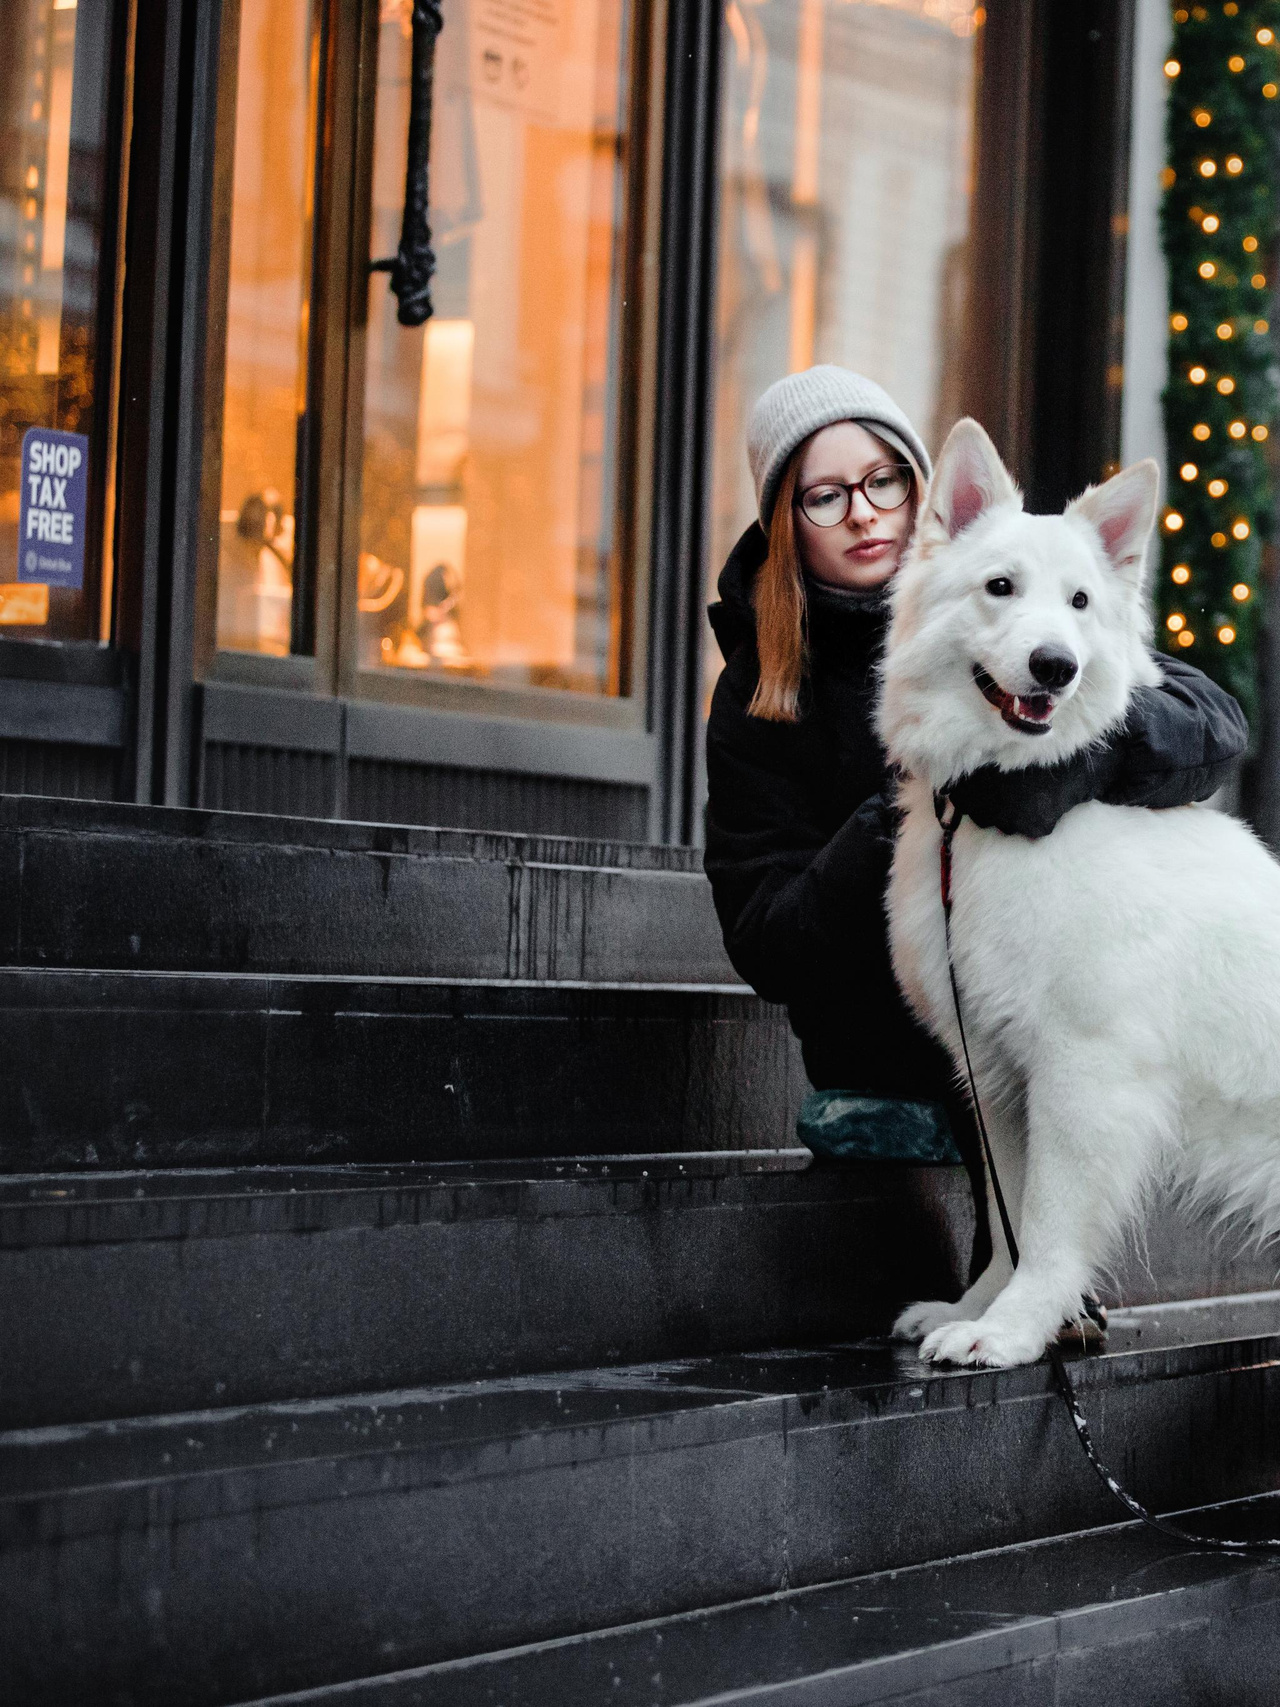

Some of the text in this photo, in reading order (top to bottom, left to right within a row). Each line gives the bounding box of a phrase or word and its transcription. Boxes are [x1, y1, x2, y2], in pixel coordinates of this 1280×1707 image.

[29, 440, 82, 478] SHOP
[28, 474, 67, 510] TAX
[26, 507, 74, 545] FREE
